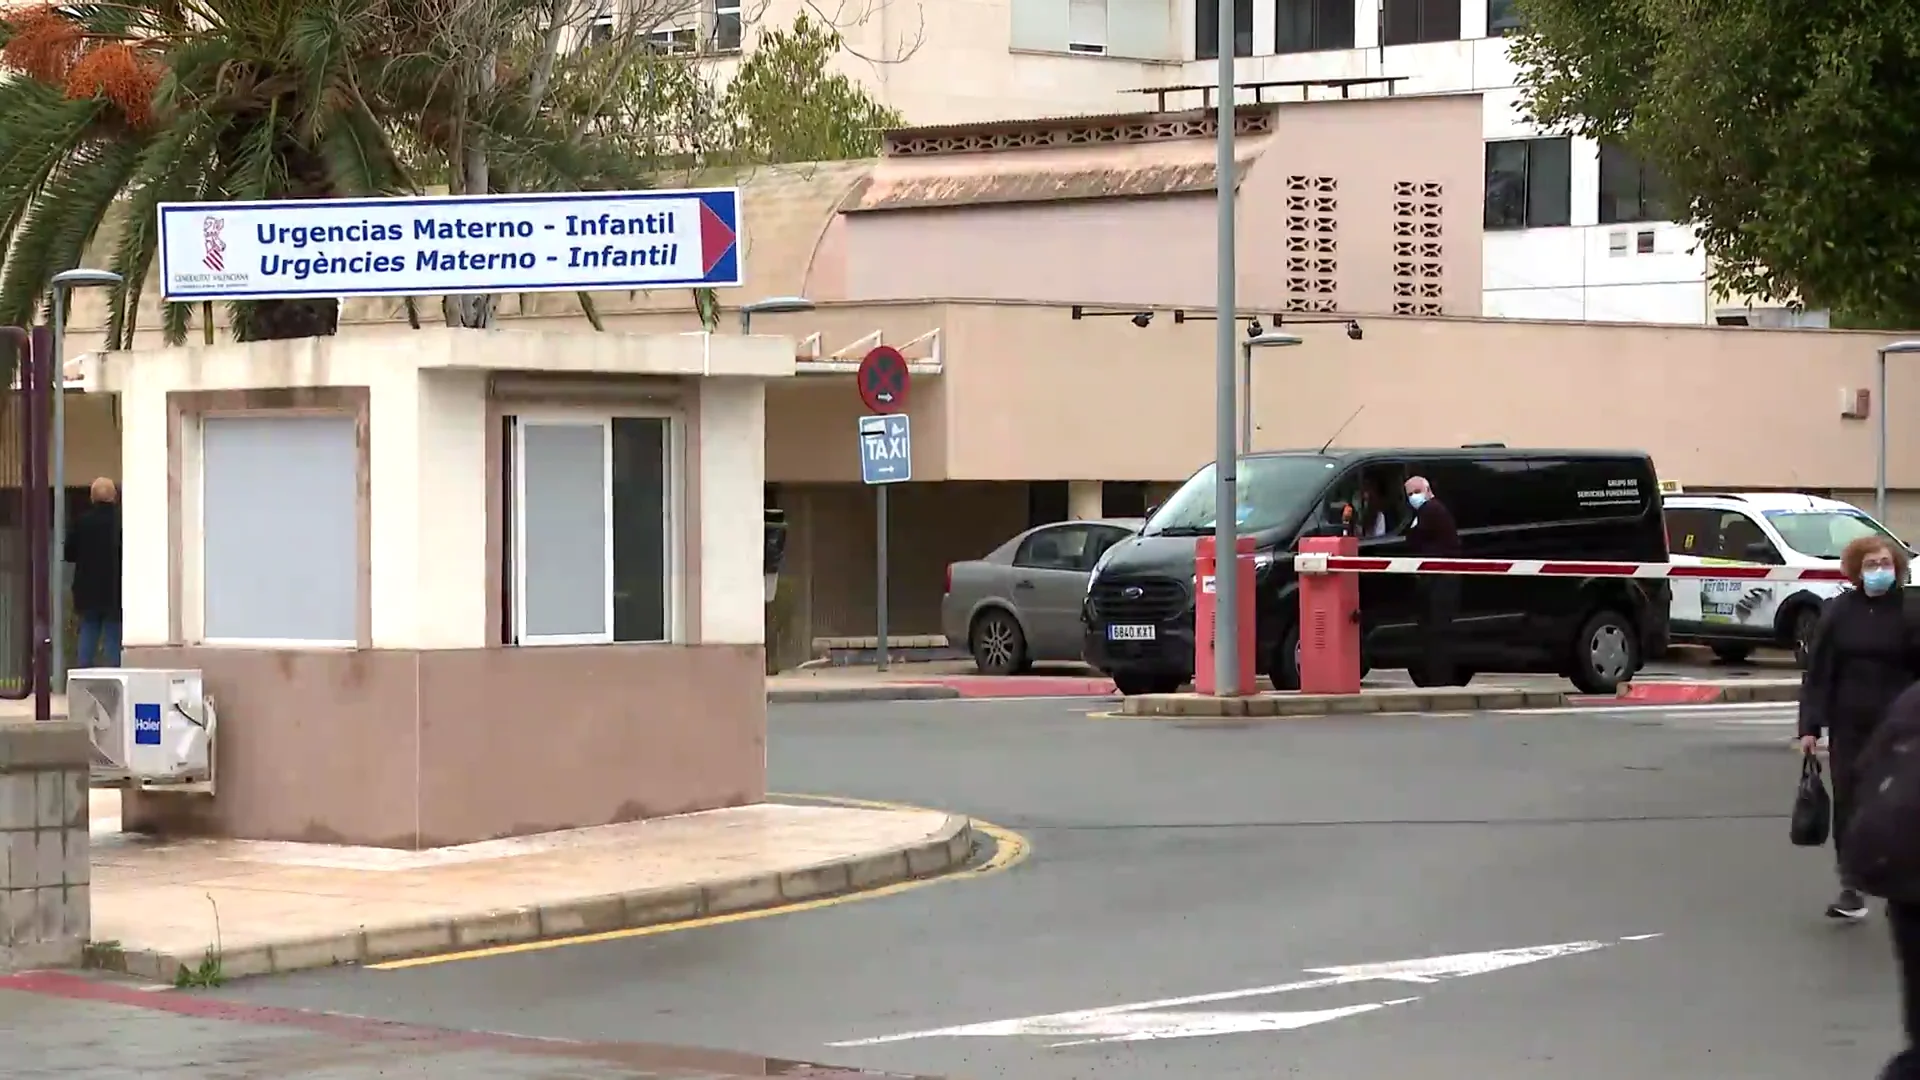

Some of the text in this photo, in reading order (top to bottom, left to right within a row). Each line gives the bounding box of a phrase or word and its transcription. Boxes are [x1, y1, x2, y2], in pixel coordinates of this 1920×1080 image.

[257, 219, 403, 248] Urgencias
[414, 216, 534, 240] Materno
[565, 211, 674, 236] Infantil
[260, 251, 404, 280] Urgències
[416, 250, 536, 272] Materno
[567, 243, 678, 268] Infantil
[866, 437, 907, 461] TAXI
[1114, 625, 1135, 638] 6840
[135, 718, 160, 731] Haier
